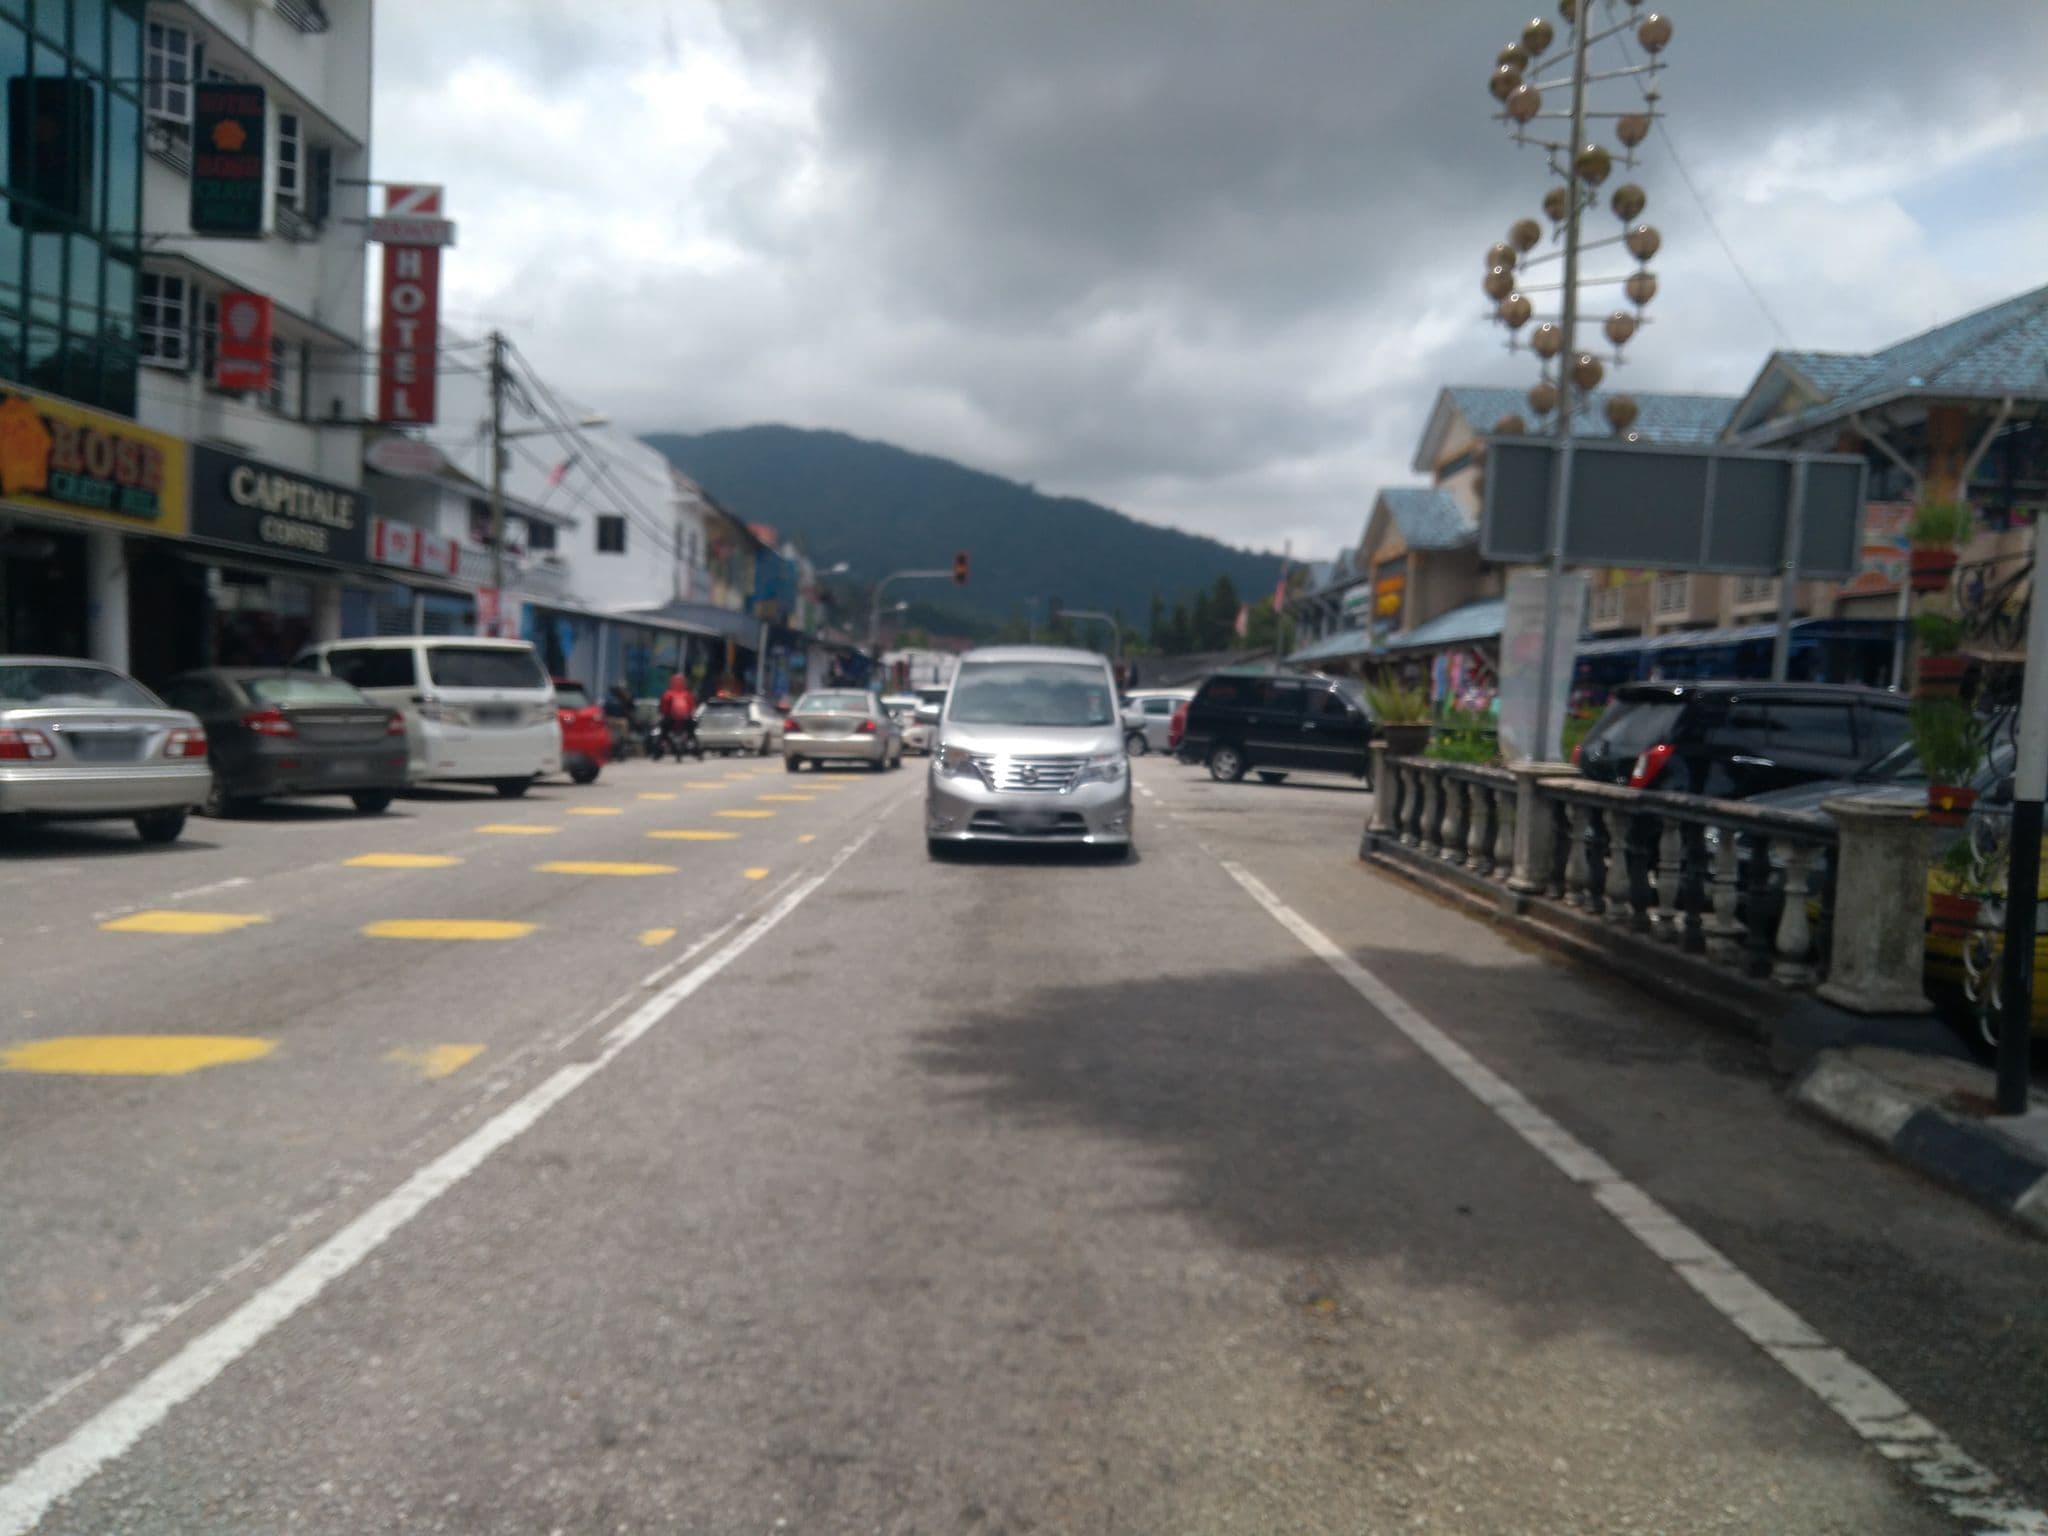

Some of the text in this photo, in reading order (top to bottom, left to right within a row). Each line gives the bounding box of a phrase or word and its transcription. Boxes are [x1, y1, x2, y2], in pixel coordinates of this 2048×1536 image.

[389, 249, 426, 420] HOTEL
[49, 416, 163, 488] ROSE
[230, 465, 354, 530] CAPITALE
[260, 514, 328, 553] COFFEE
